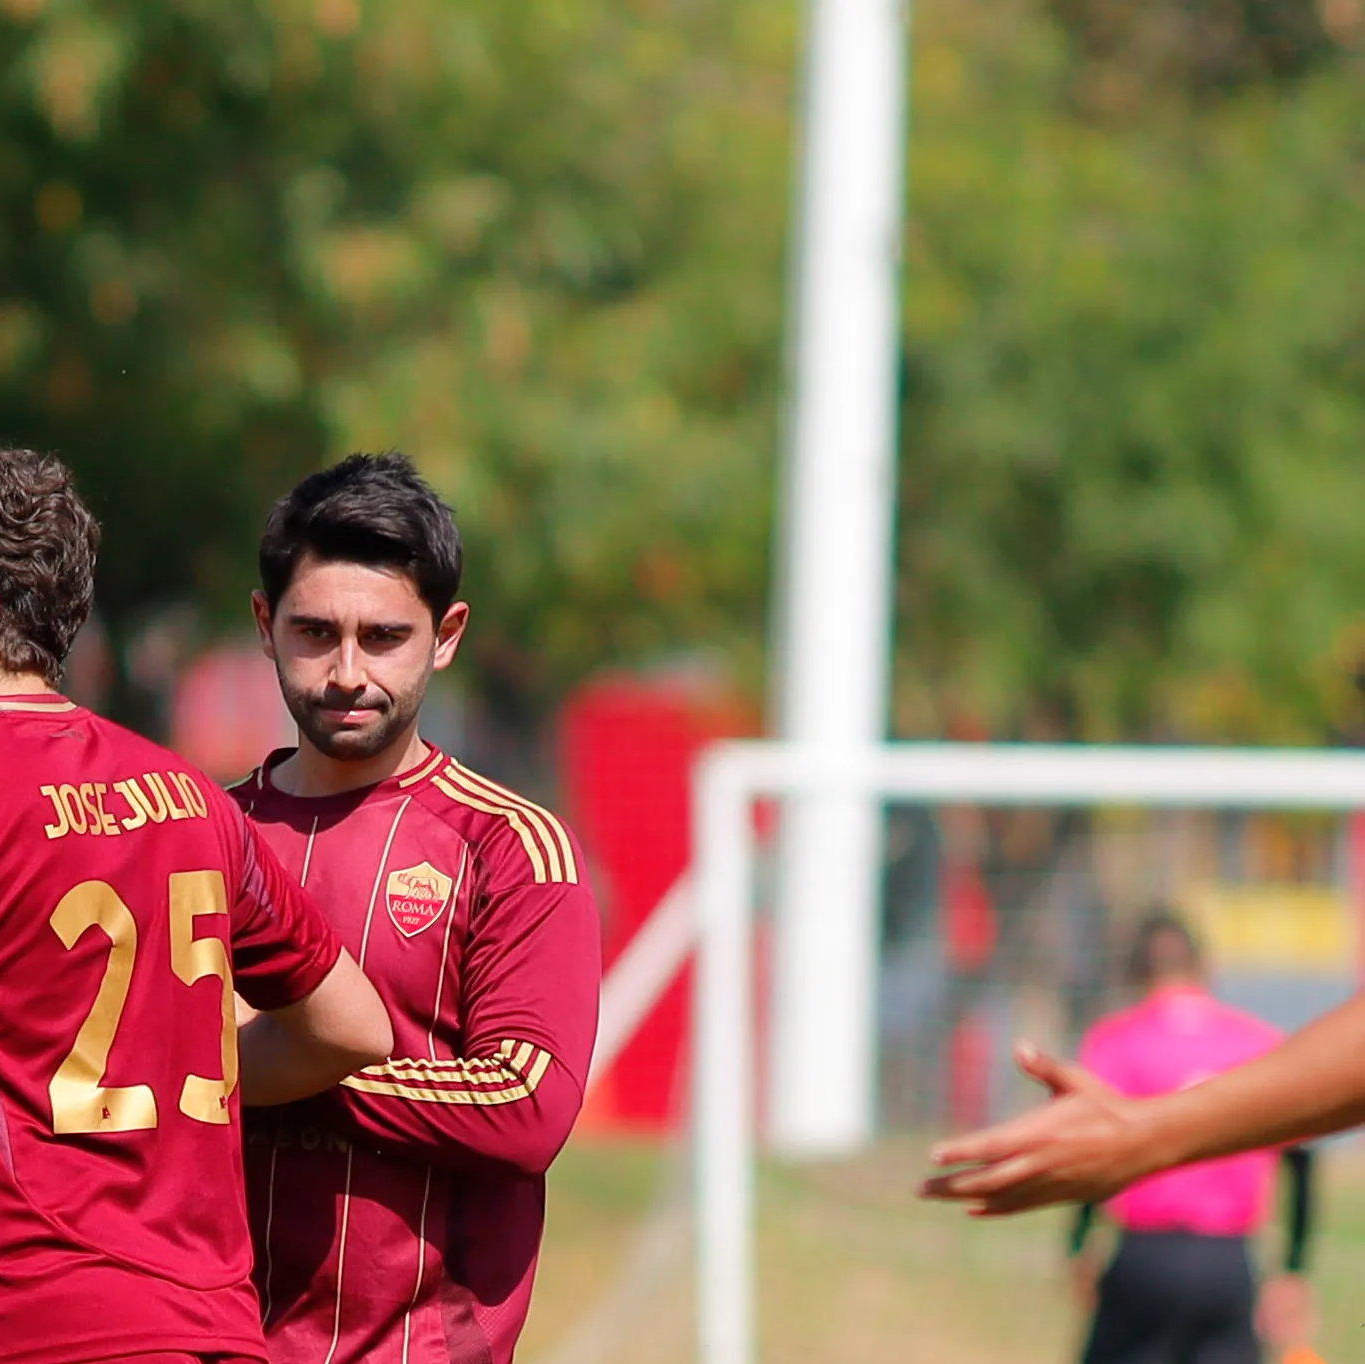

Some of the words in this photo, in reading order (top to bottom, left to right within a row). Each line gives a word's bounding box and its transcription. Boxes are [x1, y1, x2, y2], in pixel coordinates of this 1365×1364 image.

[39, 782, 121, 840] JOSE
[112, 771, 209, 831] JULIO
[392, 900, 435, 917] ROMA
[48, 869, 239, 1134] 25
